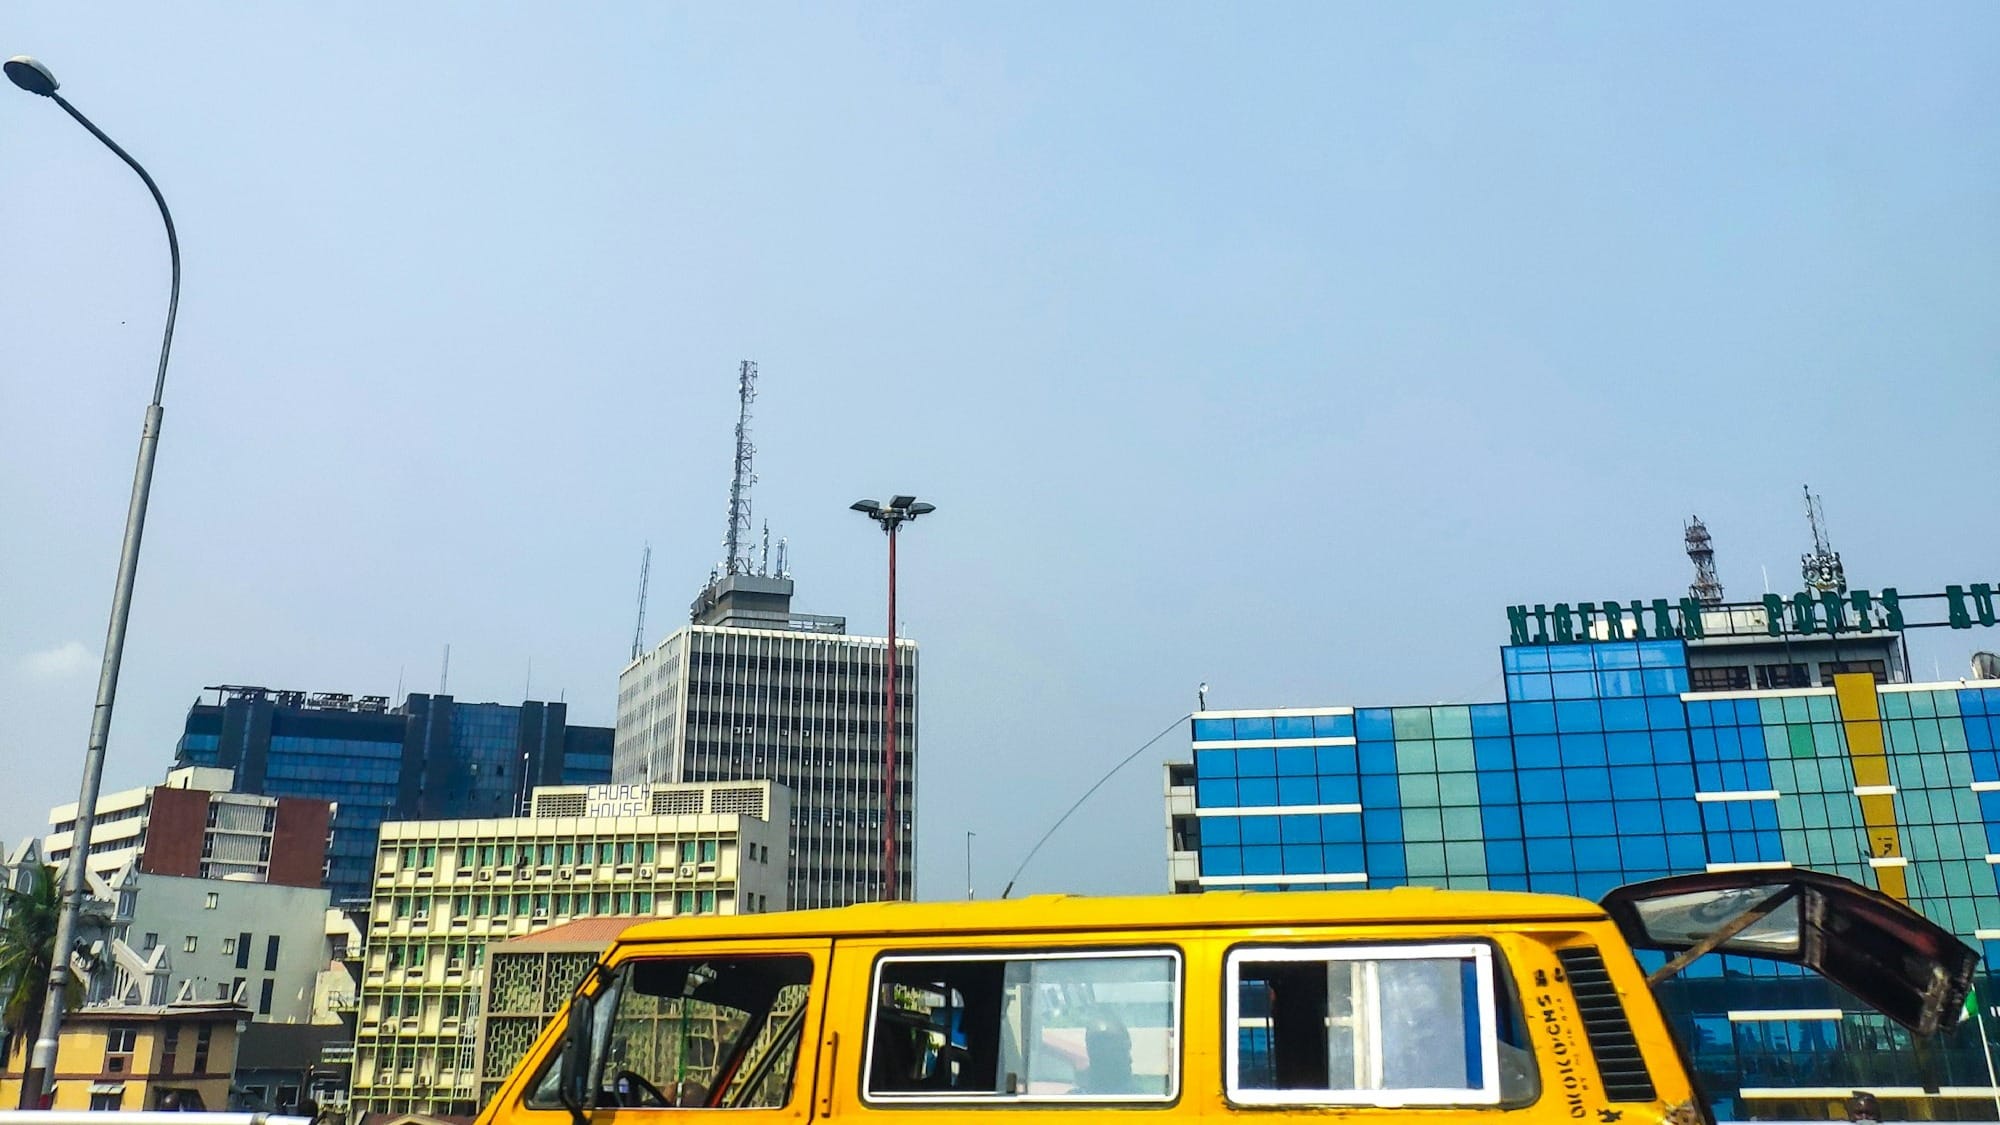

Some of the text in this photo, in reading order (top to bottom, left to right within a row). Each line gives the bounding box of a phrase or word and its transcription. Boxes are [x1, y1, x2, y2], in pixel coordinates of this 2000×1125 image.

[1507, 583, 2000, 646] NIGERIAN PORTS AU
